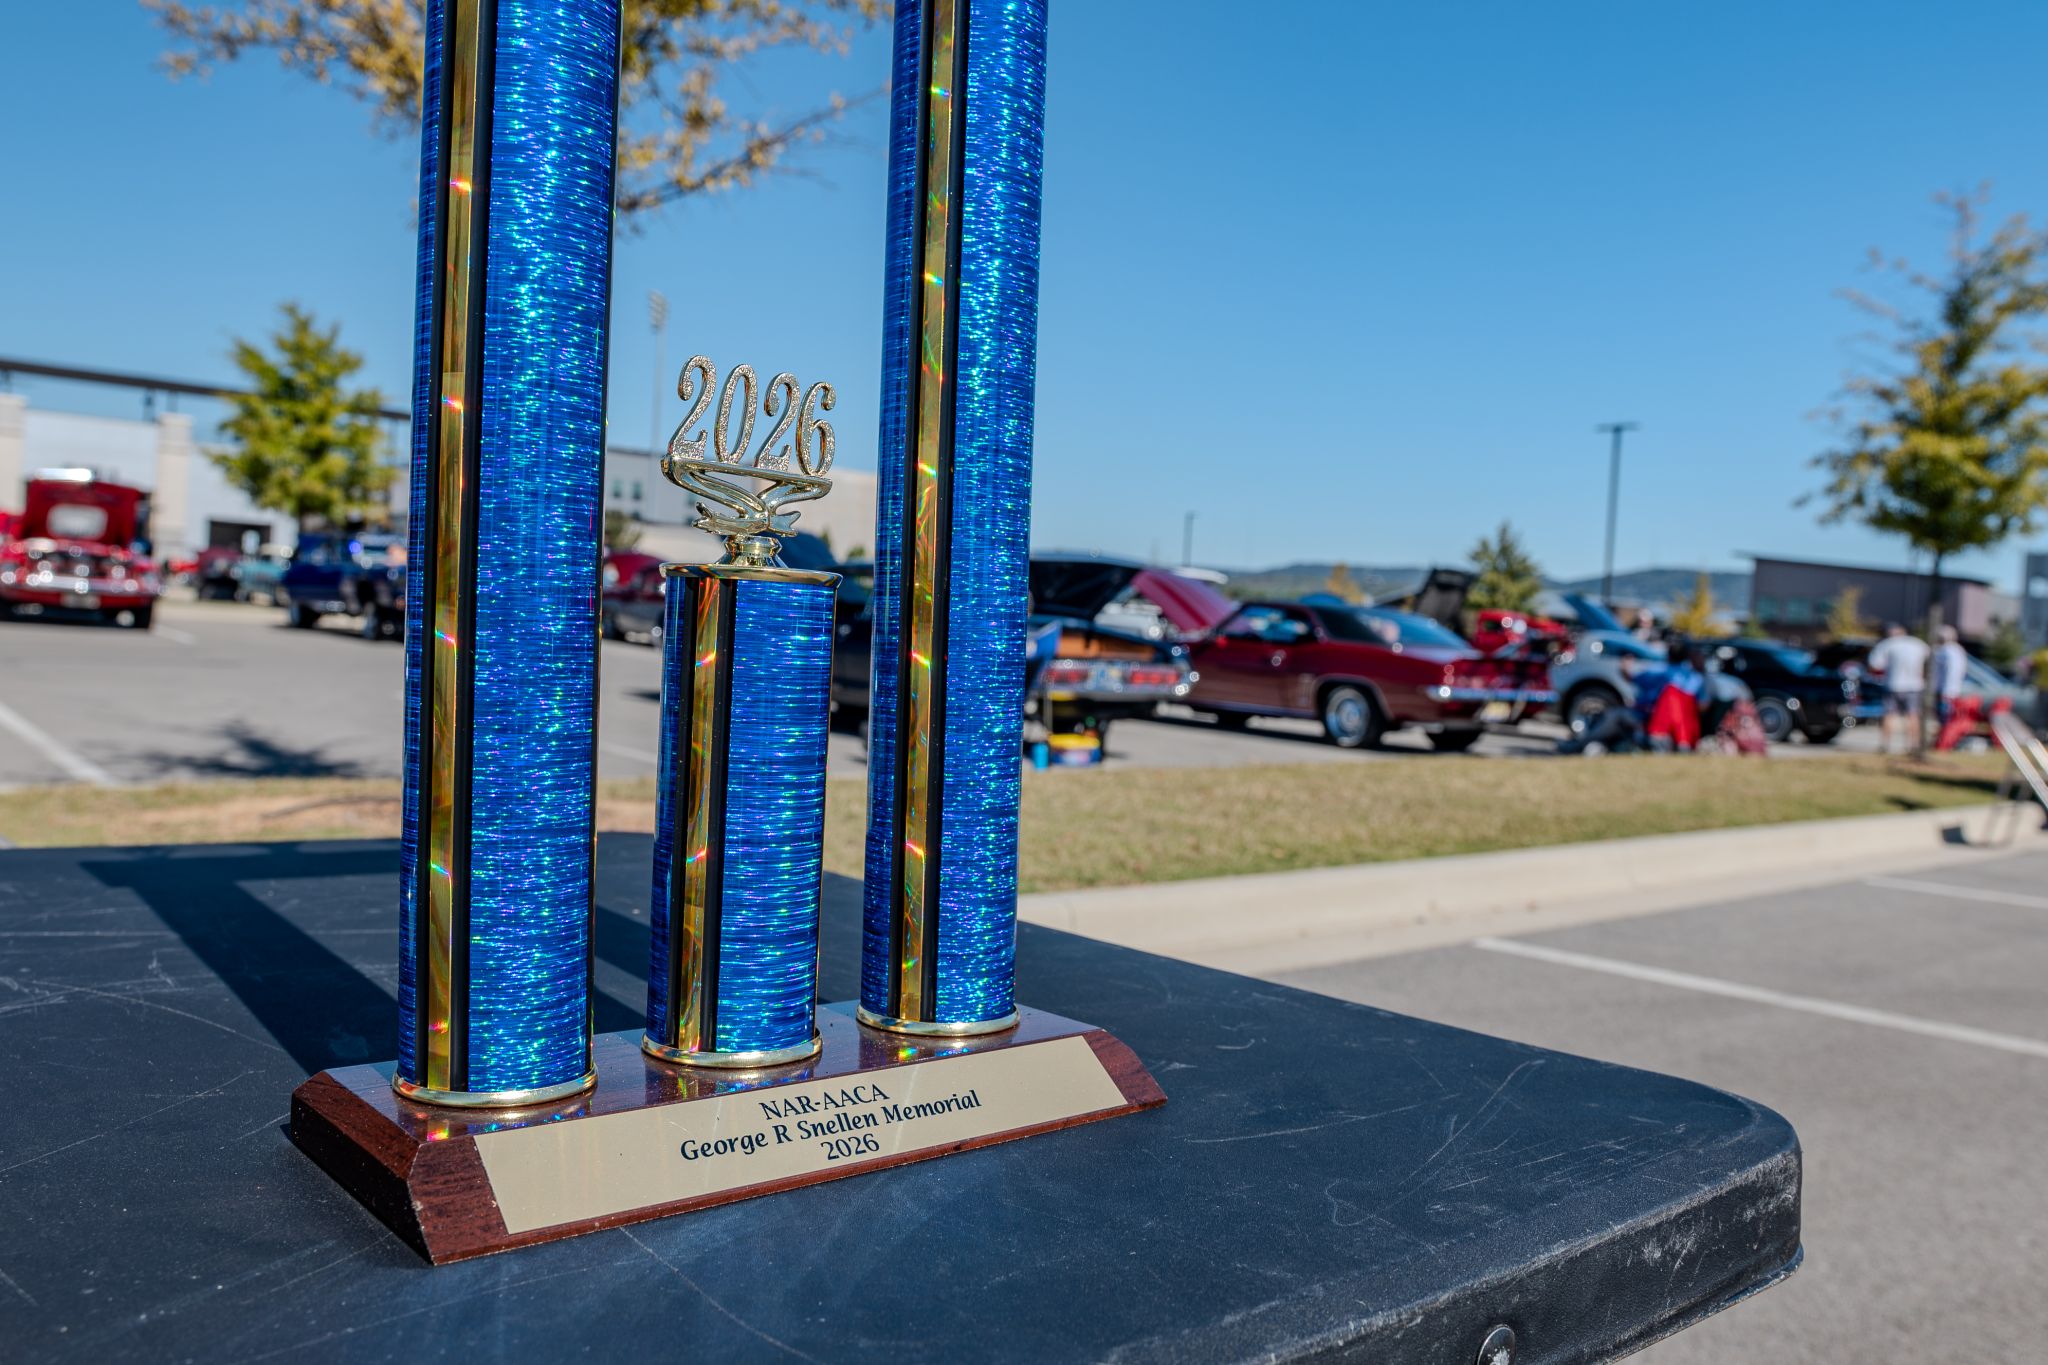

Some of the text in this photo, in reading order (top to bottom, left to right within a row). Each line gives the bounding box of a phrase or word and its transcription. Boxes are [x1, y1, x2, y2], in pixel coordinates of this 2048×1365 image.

[669, 355, 836, 477] 2026
[680, 1090, 982, 1161] George R Snellen Memorial
[759, 1083, 890, 1121] NAR-AACA
[821, 1133, 880, 1161] 2026
